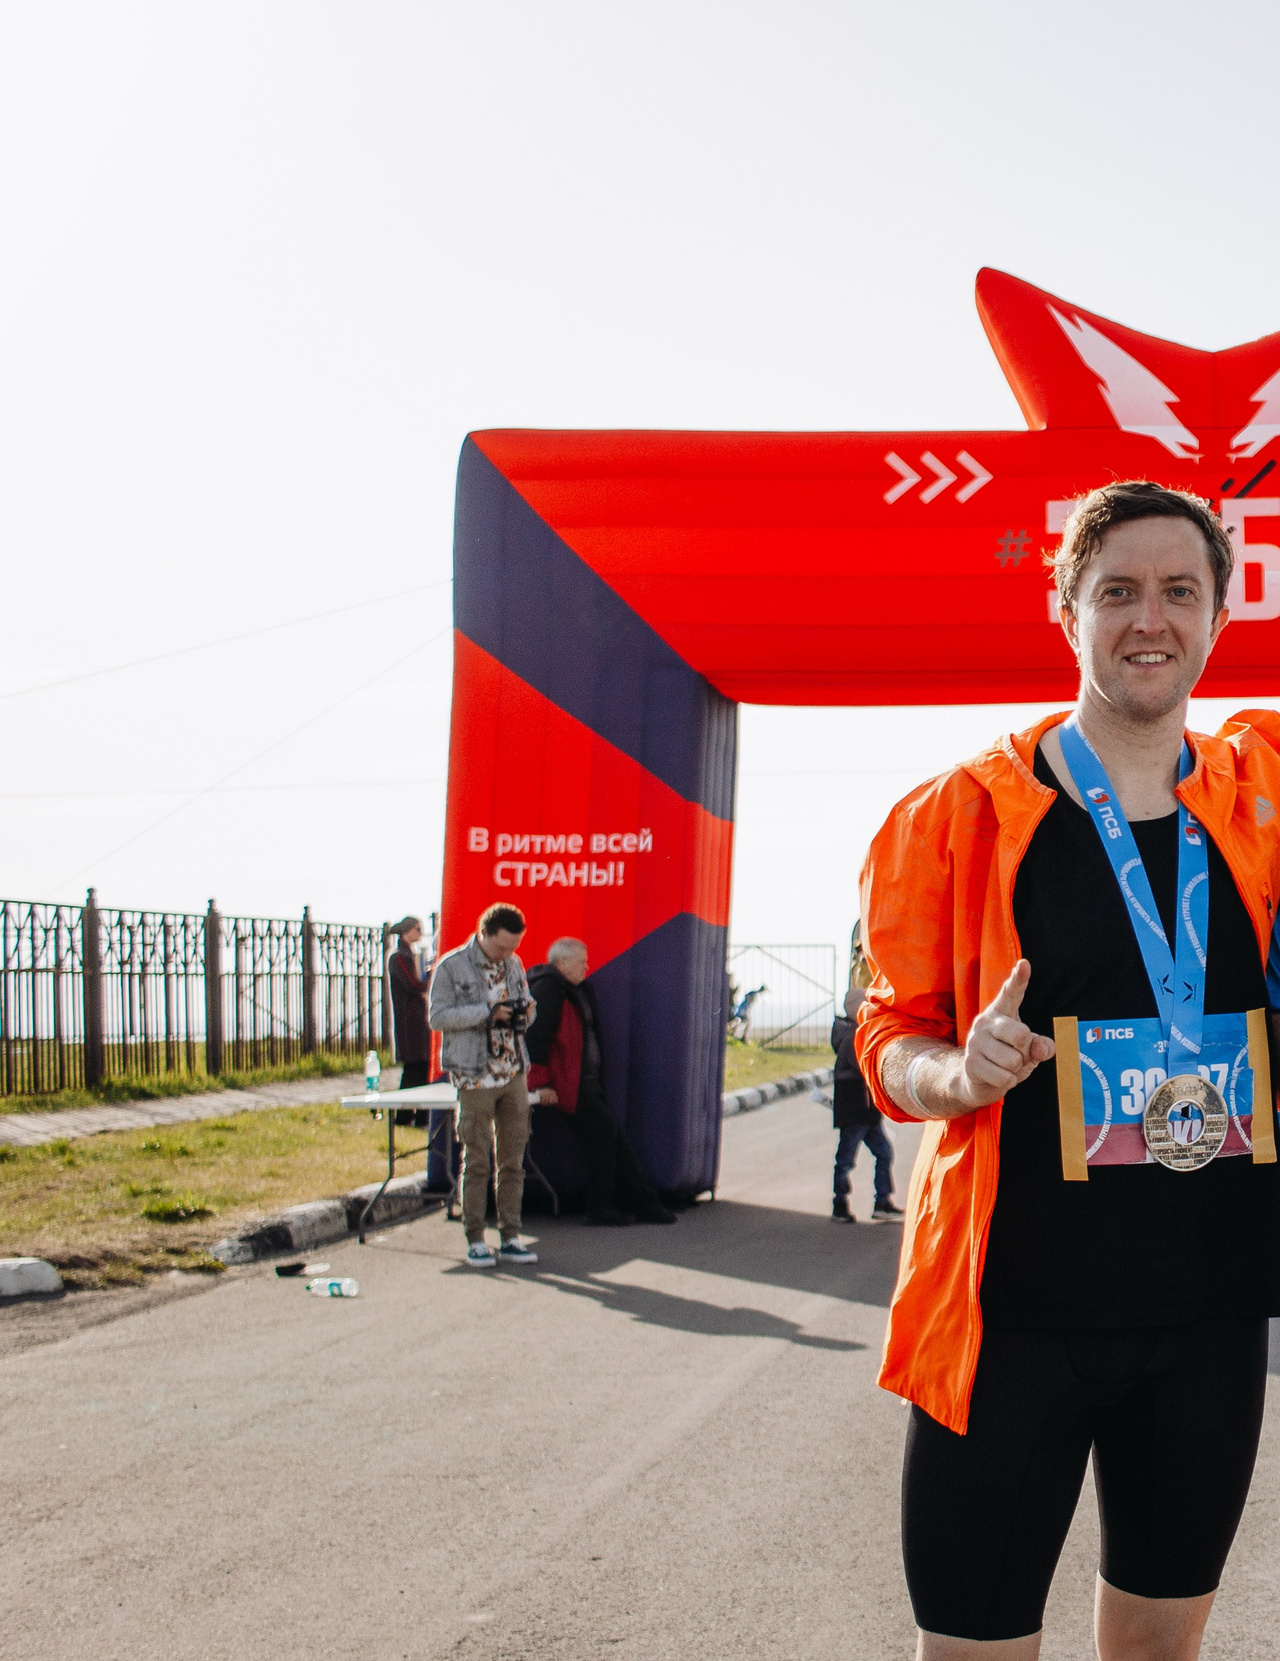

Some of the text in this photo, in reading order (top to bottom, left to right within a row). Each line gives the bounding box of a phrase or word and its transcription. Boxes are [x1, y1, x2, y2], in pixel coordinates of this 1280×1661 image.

[1098, 805, 1122, 840] ПСБ
[469, 826, 653, 856] В ритме всей
[494, 861, 625, 887] СТРАНЫ!
[1105, 1027, 1135, 1041] ПСБ
